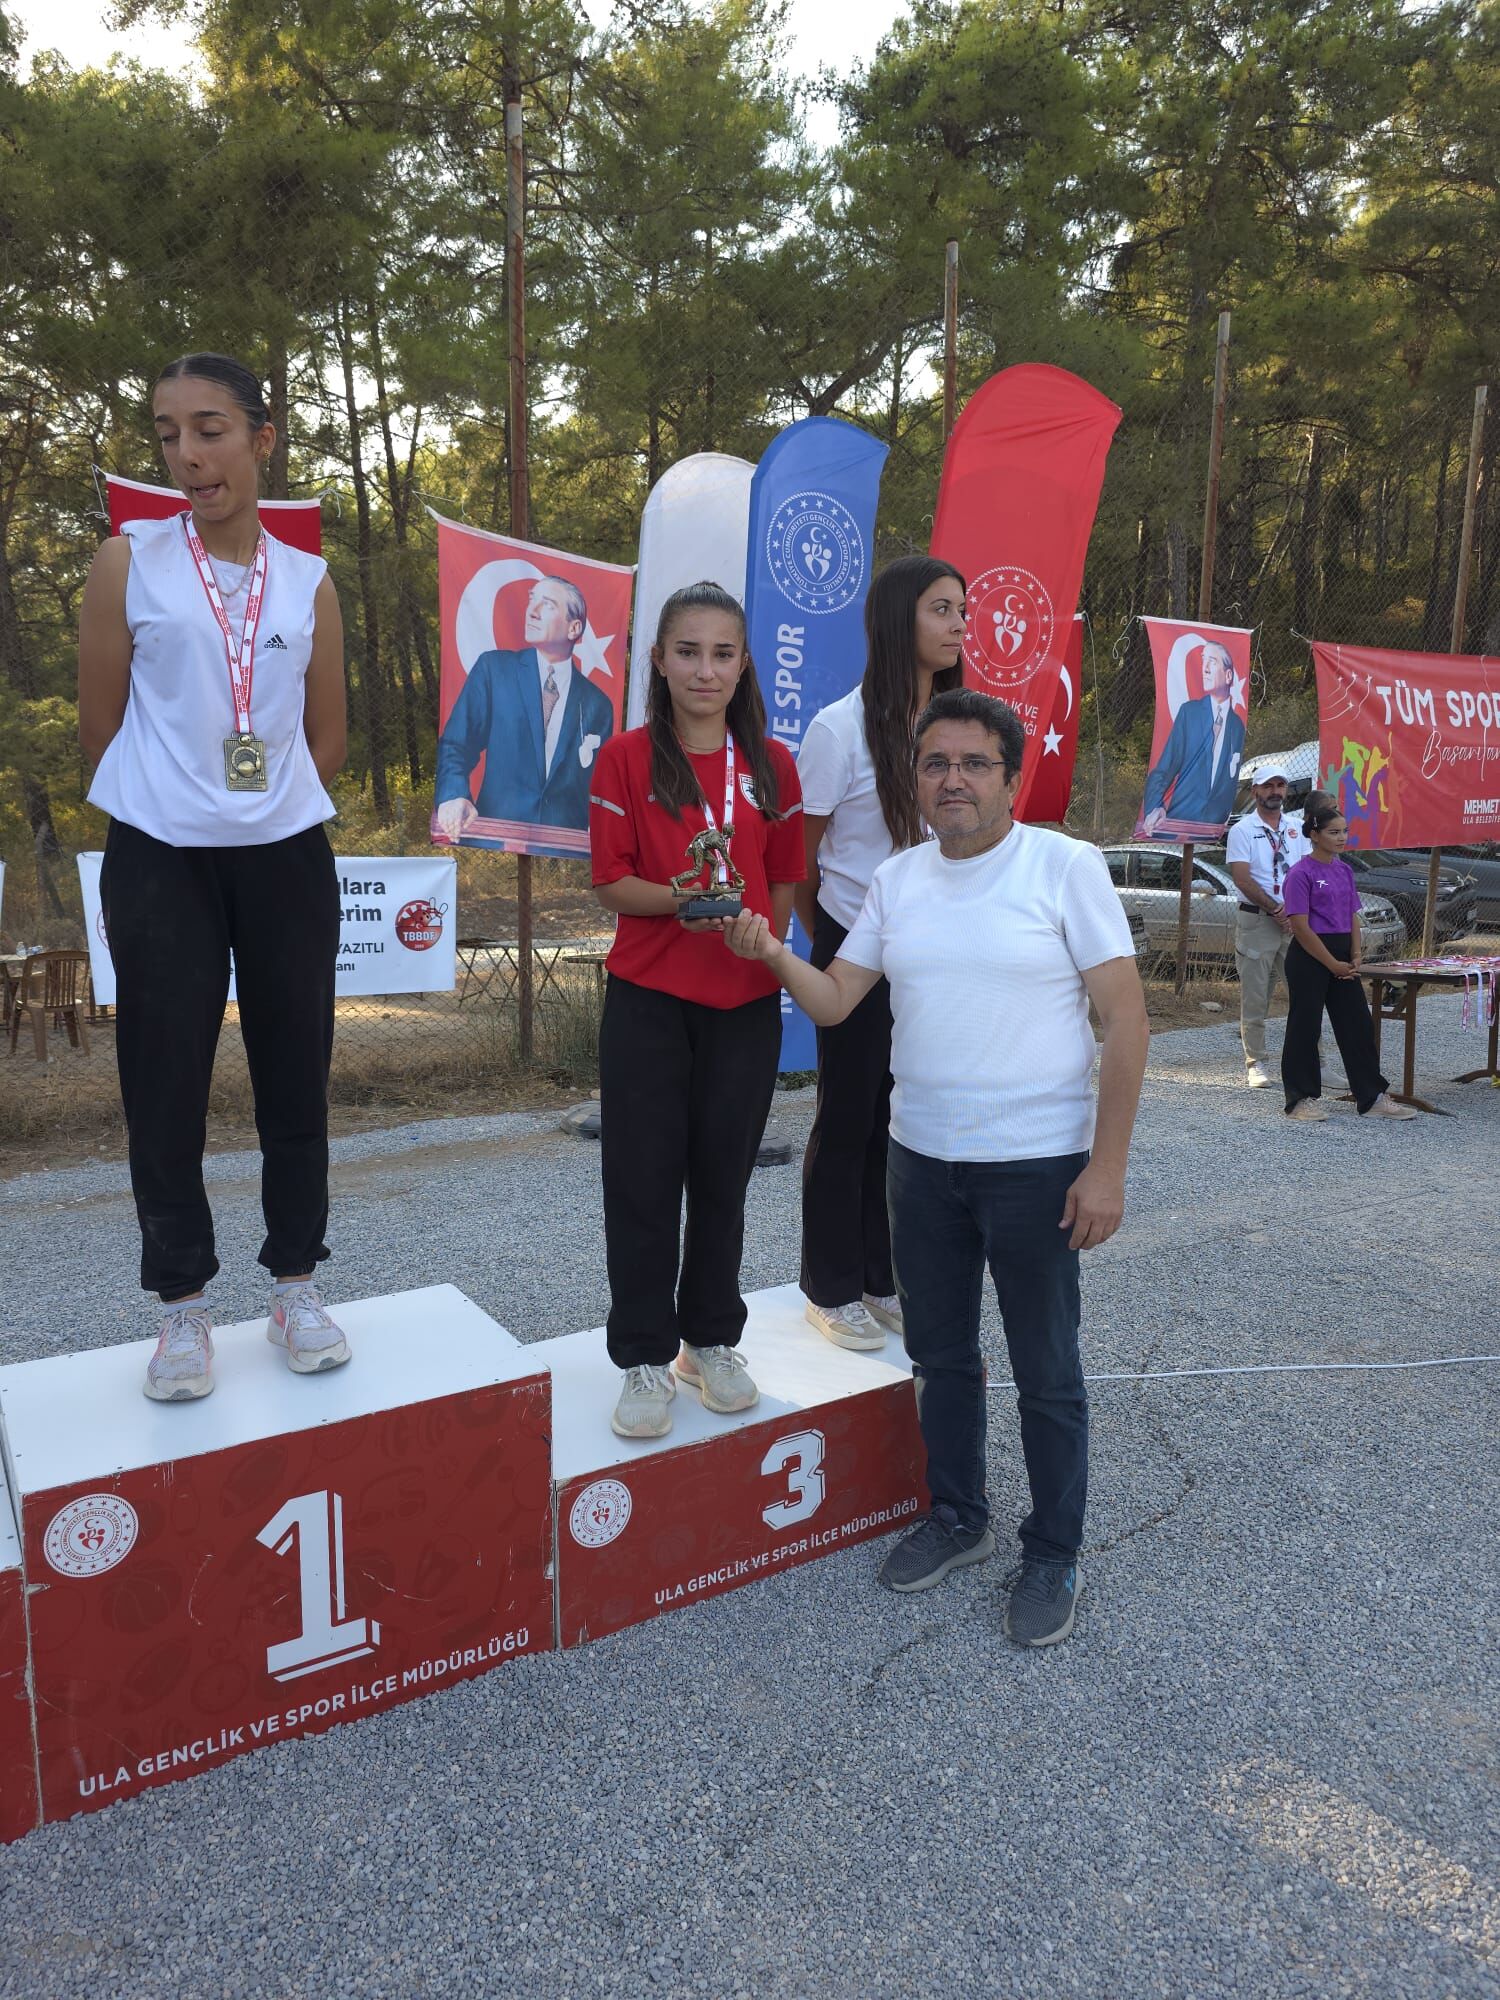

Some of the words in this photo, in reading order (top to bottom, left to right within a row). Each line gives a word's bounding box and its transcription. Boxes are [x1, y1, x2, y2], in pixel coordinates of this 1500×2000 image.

[809, 513, 837, 531] GENÇLİK
[835, 528, 845, 539] VE
[785, 514, 808, 558] CUMHURİYETİ
[840, 539, 849, 561] SPOR
[823, 562, 849, 592] BAKANLIĞI
[774, 623, 805, 710] SPOR
[1024, 704, 1039, 719] VE
[1376, 679, 1437, 726] TÜM
[1446, 690, 1500, 729] SPOR
[1462, 816, 1474, 825] ULA
[1475, 814, 1500, 825] BELEDİYE
[1463, 799, 1500, 815] MEHMET
[339, 904, 382, 922] erim
[403, 931, 435, 942] TBBDF
[761, 1428, 826, 1531] 3
[655, 1583, 685, 1605] ULA
[687, 1559, 749, 1593] GENÇLİK
[751, 1551, 769, 1570] VE
[772, 1540, 808, 1563] SPOR
[810, 1527, 838, 1551] İLÇE
[841, 1497, 919, 1538] MÜDÜRLÜĞÜ
[255, 1489, 383, 1683] 1
[79, 1766, 131, 1797] ULA
[137, 1728, 244, 1777] GENÇLİK
[250, 1714, 280, 1739] VE
[285, 1693, 345, 1727] SPOR
[351, 1674, 398, 1705] İLÇE
[403, 1627, 530, 1687] MÜDÜRLÜĞÜ
